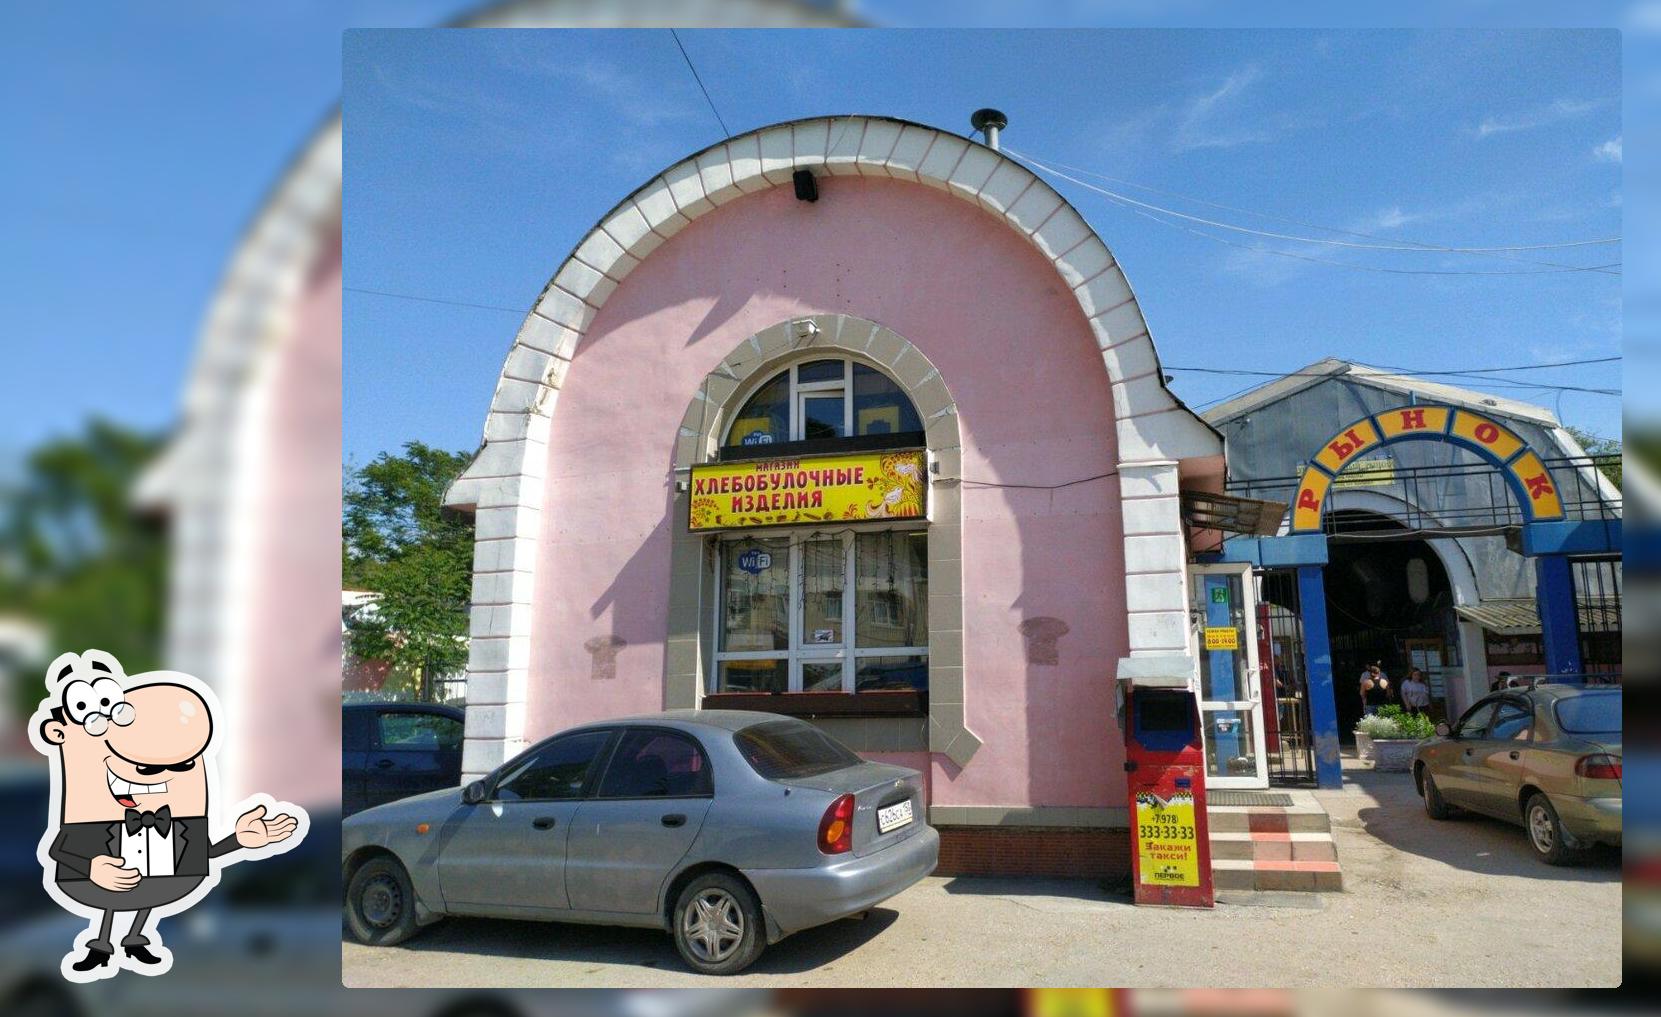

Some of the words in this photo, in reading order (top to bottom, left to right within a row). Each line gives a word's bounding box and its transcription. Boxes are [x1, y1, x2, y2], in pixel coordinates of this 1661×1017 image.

[756, 460, 800, 472] МАГАЗИН
[1298, 409, 1554, 512] РЫНОК
[694, 467, 864, 496] ХЛЕБОБУЛОЧНЫЕ
[731, 490, 823, 513] ИЗДЕЛИЯ
[1145, 842, 1191, 851] Закажи
[1151, 852, 1188, 861] такси!
